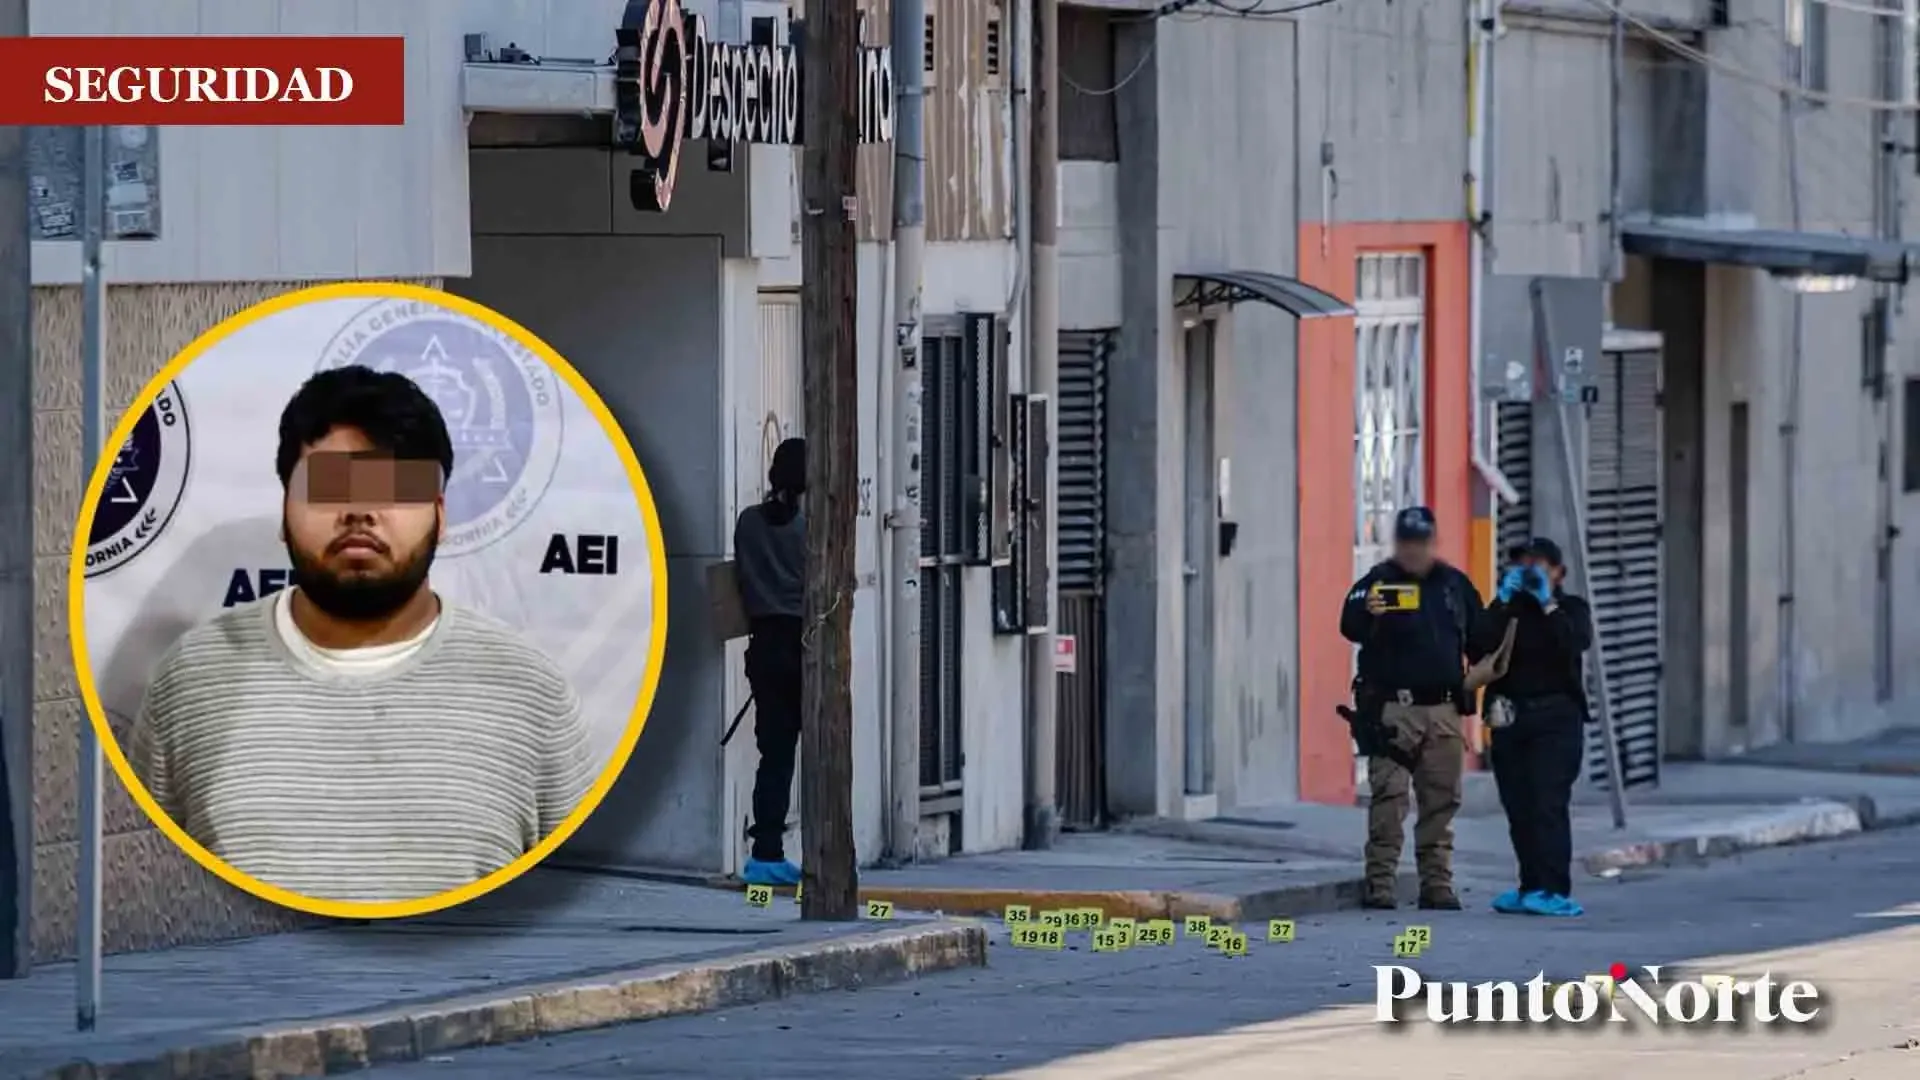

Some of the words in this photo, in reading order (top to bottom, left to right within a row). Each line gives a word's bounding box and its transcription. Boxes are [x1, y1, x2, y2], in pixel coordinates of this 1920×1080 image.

[691, 12, 798, 173] Despecho
[540, 534, 618, 575] AEI
[750, 890, 768, 902] 28
[870, 904, 889, 917] 27
[1008, 910, 1027, 922] 35
[1189, 920, 1207, 932] 38
[1272, 923, 1291, 936] 37
[1020, 930, 1039, 943] 19
[1040, 931, 1058, 944] 18
[1096, 934, 1115, 946] 15
[1139, 929, 1158, 941] 25
[1223, 938, 1242, 950] 16
[1399, 941, 1417, 953] 17
